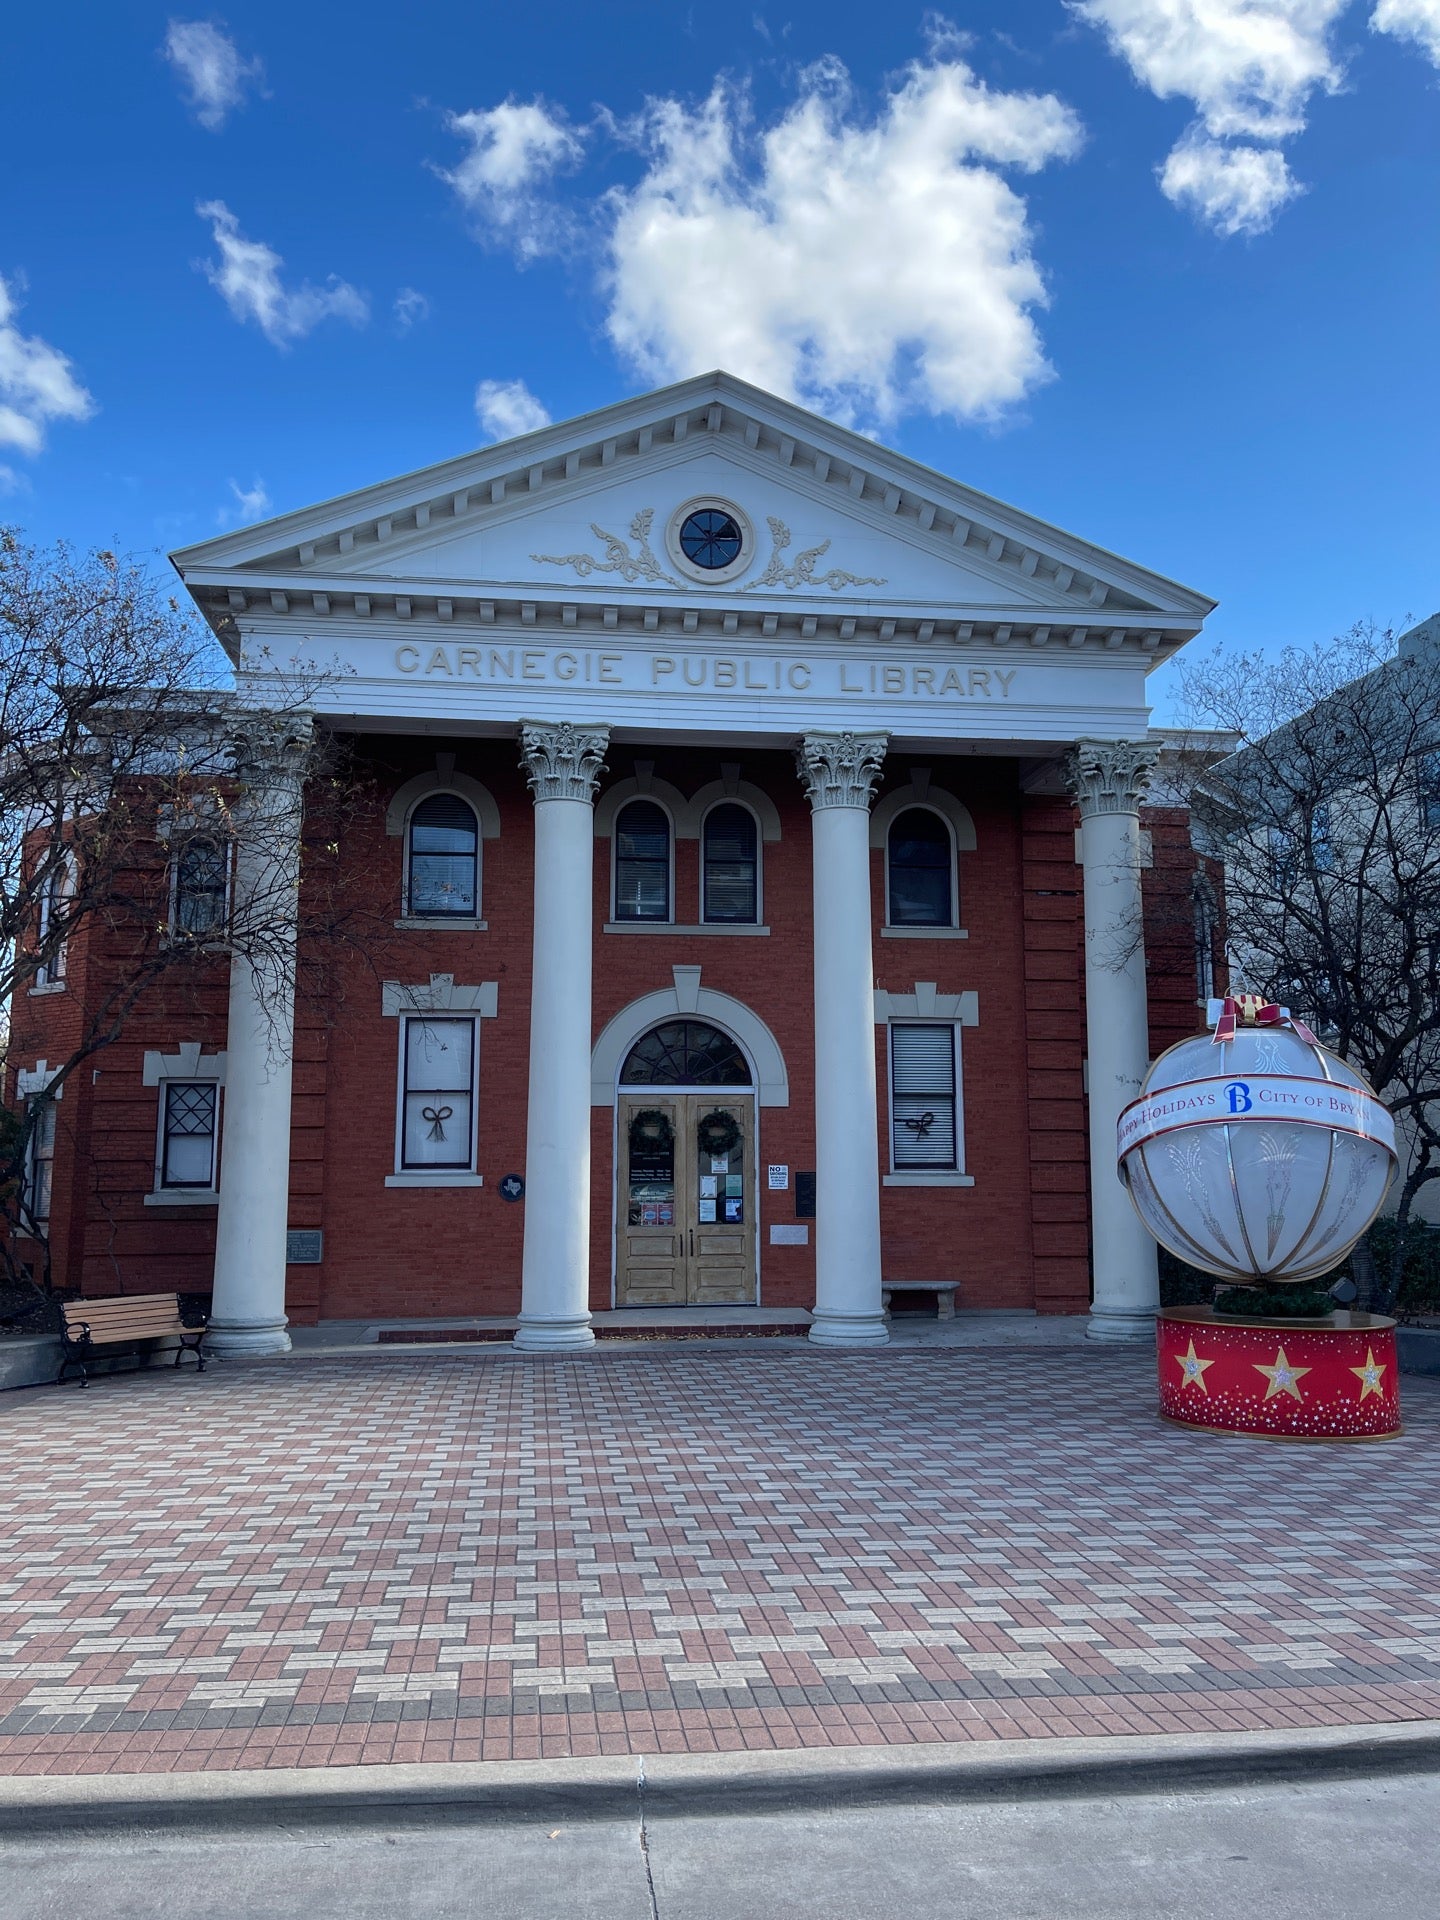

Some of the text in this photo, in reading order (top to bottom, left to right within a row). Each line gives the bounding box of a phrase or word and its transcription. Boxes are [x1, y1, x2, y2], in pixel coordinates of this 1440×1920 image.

[395, 645, 1017, 697] CARNEGIE PUBLIC LIBRARY
[1141, 1094, 1216, 1124] HOLIDAYS
[1223, 1082, 1253, 1114] B
[1259, 1089, 1300, 1104] CITY
[1329, 1097, 1371, 1121] BRYAN
